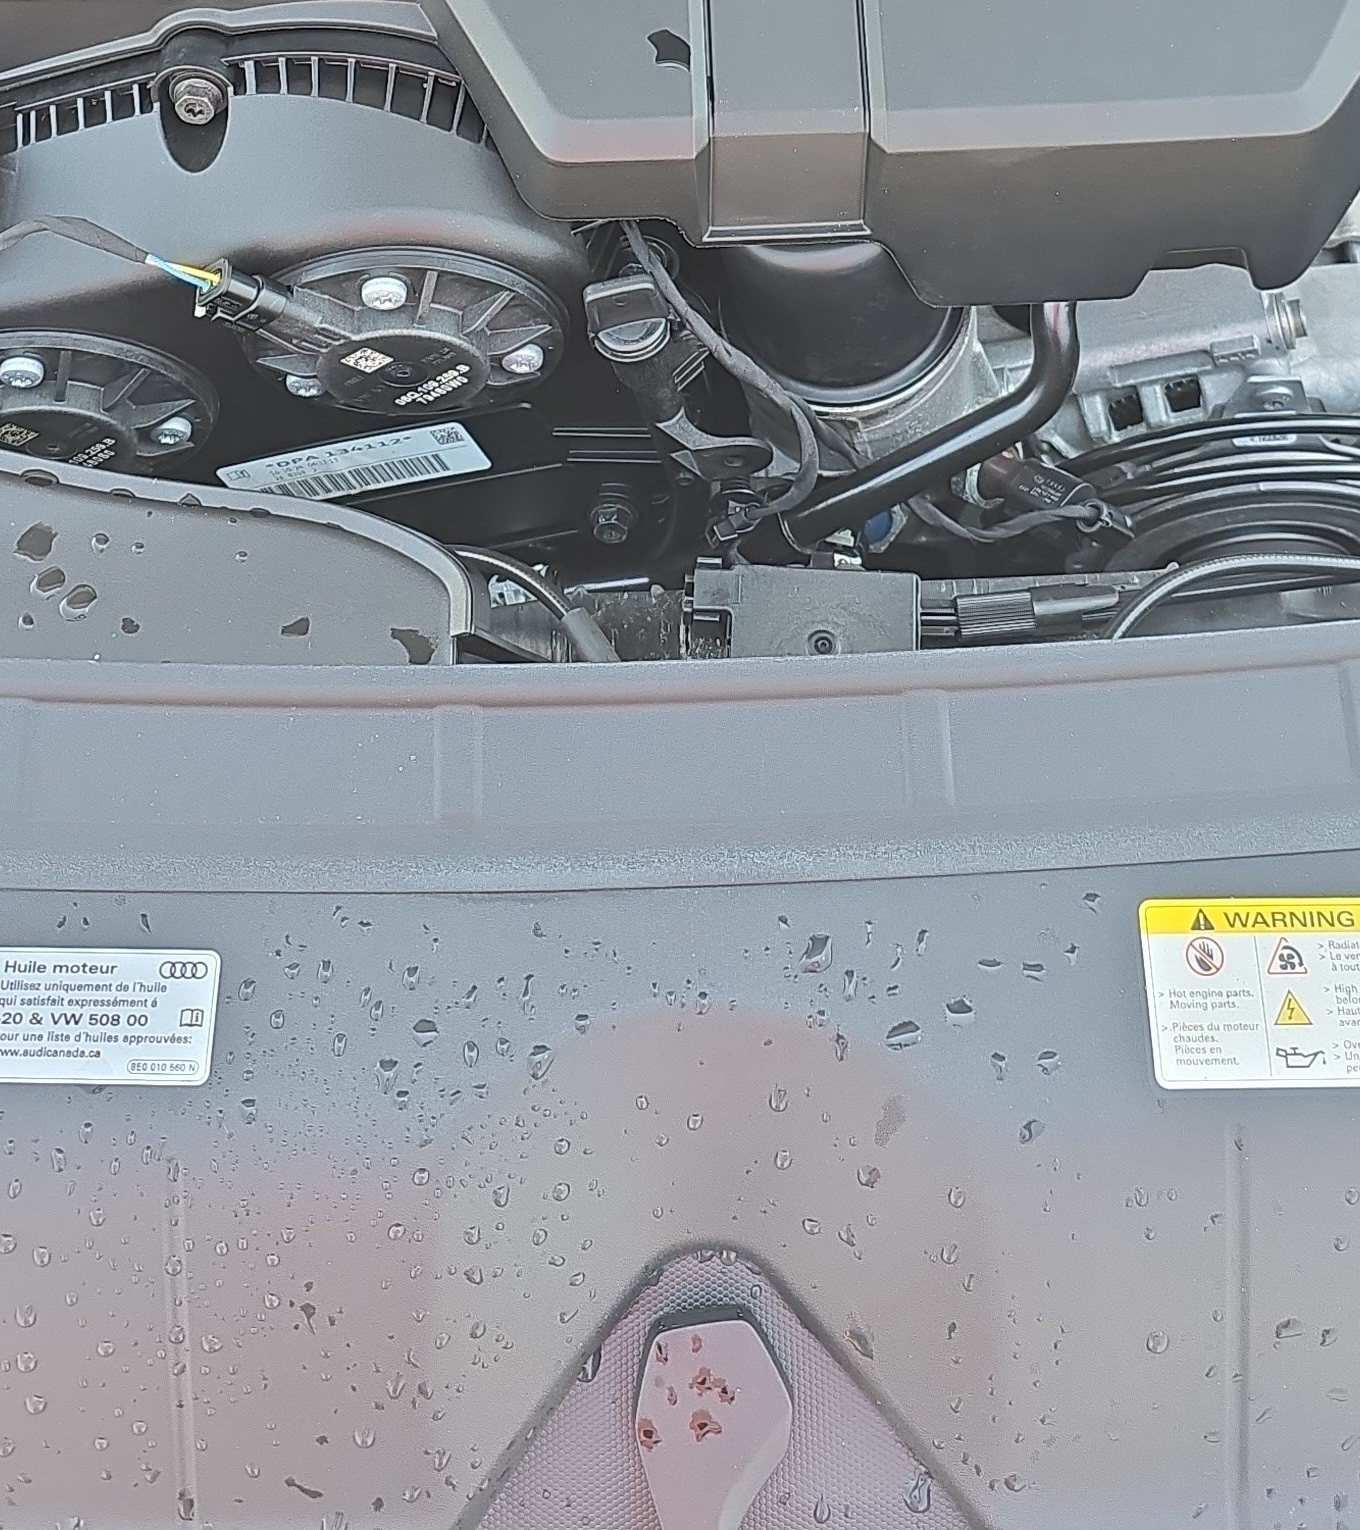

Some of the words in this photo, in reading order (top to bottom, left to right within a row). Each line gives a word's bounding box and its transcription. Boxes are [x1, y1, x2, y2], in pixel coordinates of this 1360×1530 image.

[1223, 910, 1355, 929] WARNING
[1330, 951, 1342, 960] Le
[4, 960, 47, 974] Huile
[52, 963, 118, 974] moteur
[1340, 963, 1360, 971] tout
[0, 980, 41, 992] Utilisez
[44, 981, 112, 994] uniquement
[116, 982, 129, 992] de
[1334, 983, 1358, 994] High
[1168, 988, 1187, 999] Hot
[1189, 988, 1223, 1000] engine
[1226, 989, 1255, 999] parts.
[20, 996, 64, 1007] satisfait
[67, 996, 148, 1009] expressément
[1169, 1000, 1208, 1011] Moving
[1210, 1000, 1240, 1011] parts.
[29, 1012, 44, 1025] &
[51, 1013, 83, 1026] VW
[88, 1013, 121, 1027] 508
[126, 1014, 148, 1027] 00
[1172, 1022, 1204, 1032] Pièces
[1207, 1022, 1220, 1031] du
[1223, 1022, 1259, 1031] moteur
[22, 1033, 44, 1042] une
[47, 1031, 71, 1042] liste
[122, 1032, 193, 1045] approuvées:
[1173, 1034, 1219, 1043] chaudes.
[1174, 1045, 1207, 1055] Pièces
[1345, 1051, 1360, 1060] Un
[1176, 1057, 1240, 1066] mouvement.
